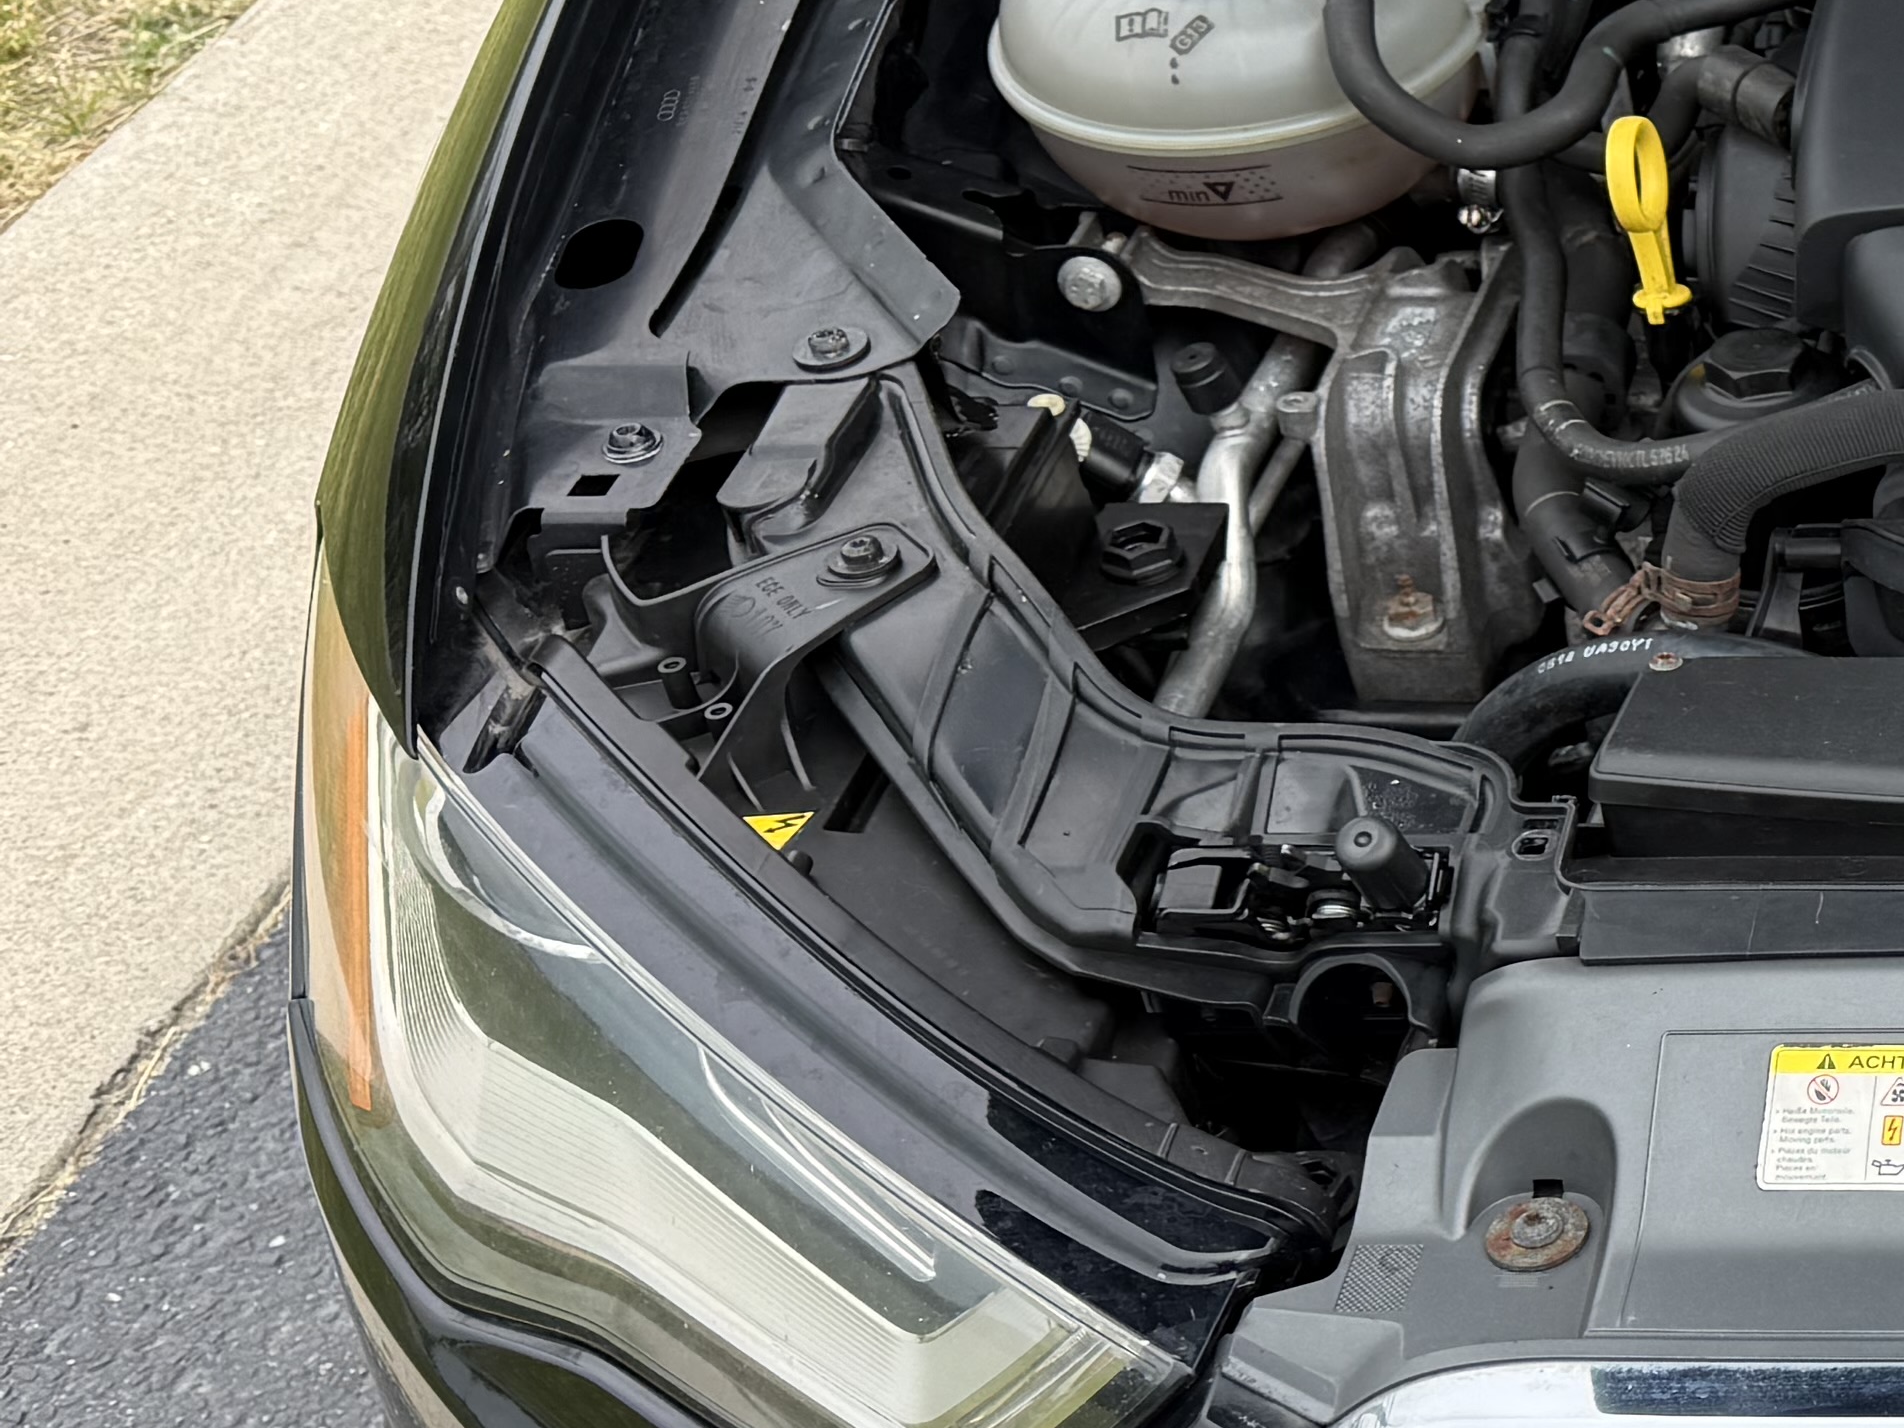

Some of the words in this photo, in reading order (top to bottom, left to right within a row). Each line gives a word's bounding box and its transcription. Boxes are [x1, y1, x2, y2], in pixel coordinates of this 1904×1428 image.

[1175, 19, 1208, 51] G13
[1167, 188, 1211, 202] min
[754, 576, 786, 597] ECE
[776, 594, 813, 620] ONLY
